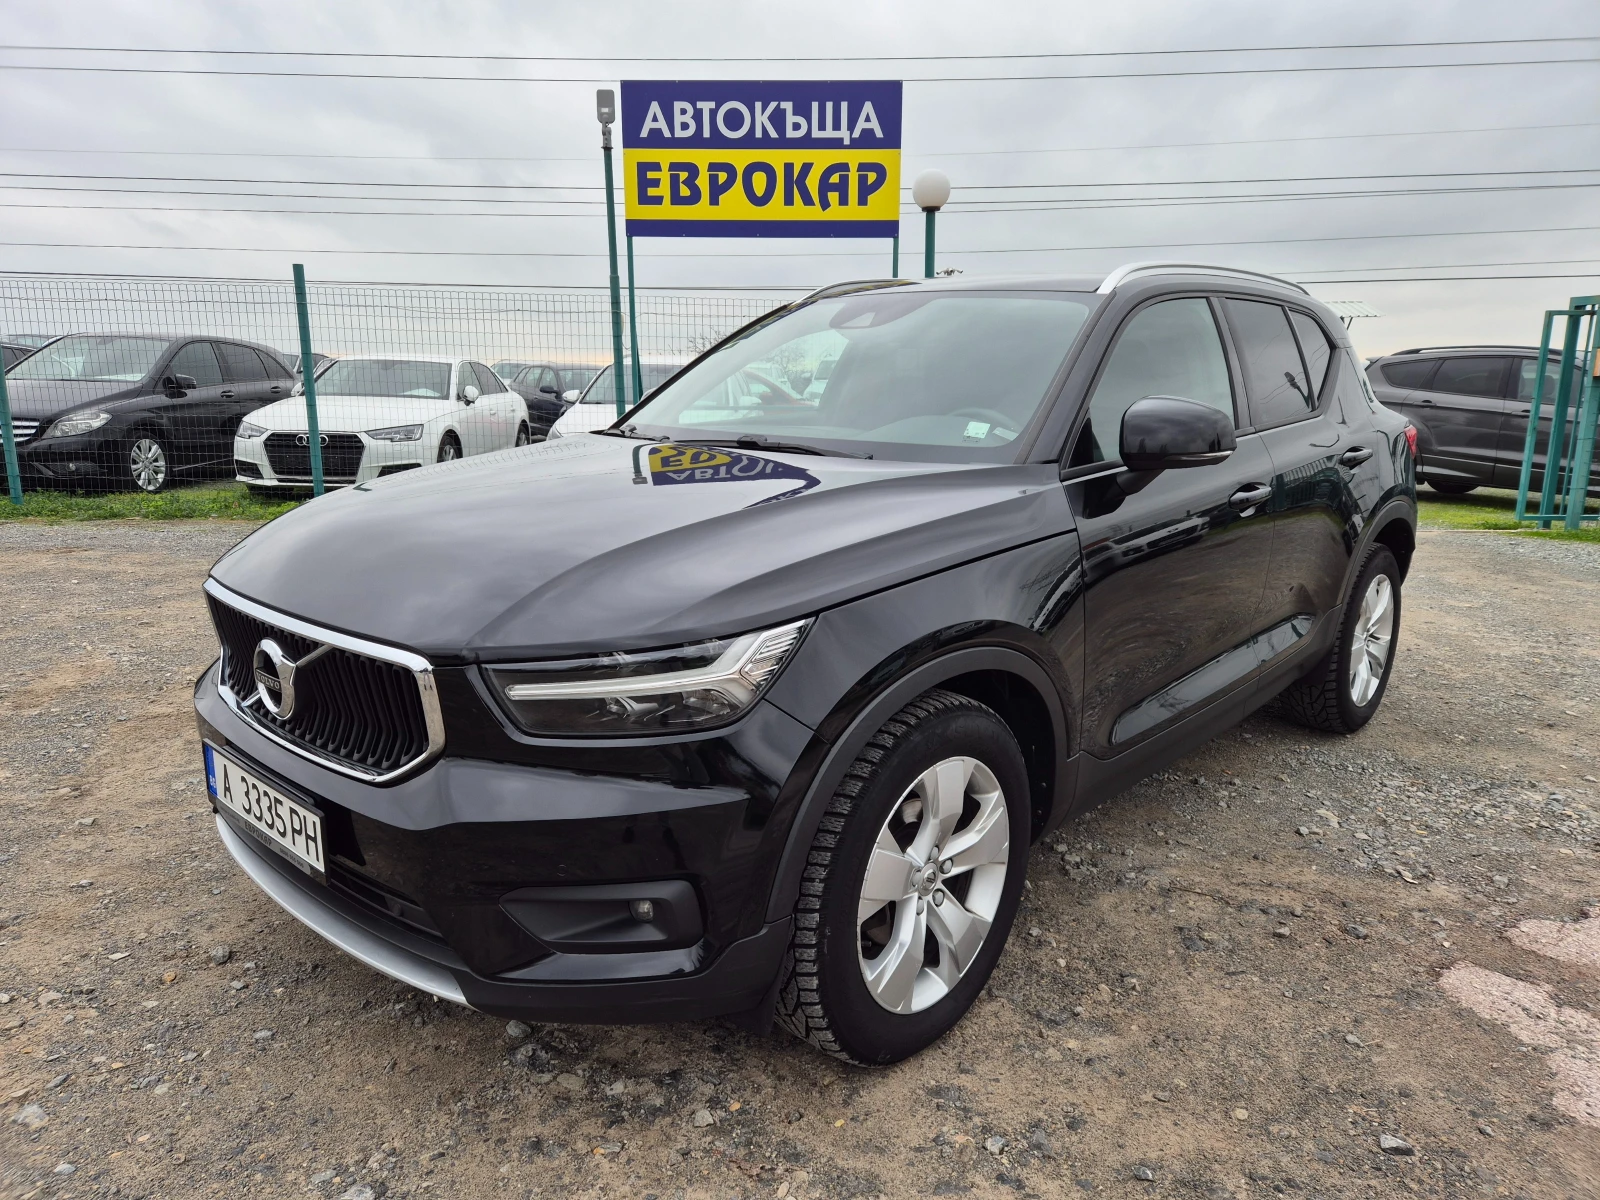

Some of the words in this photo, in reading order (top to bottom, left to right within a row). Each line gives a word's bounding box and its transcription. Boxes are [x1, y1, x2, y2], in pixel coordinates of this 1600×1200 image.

[640, 101, 884, 145] АВТОКЪЩА
[636, 161, 887, 212] ЕВРОКАР
[256, 671, 280, 689] VOLVO
